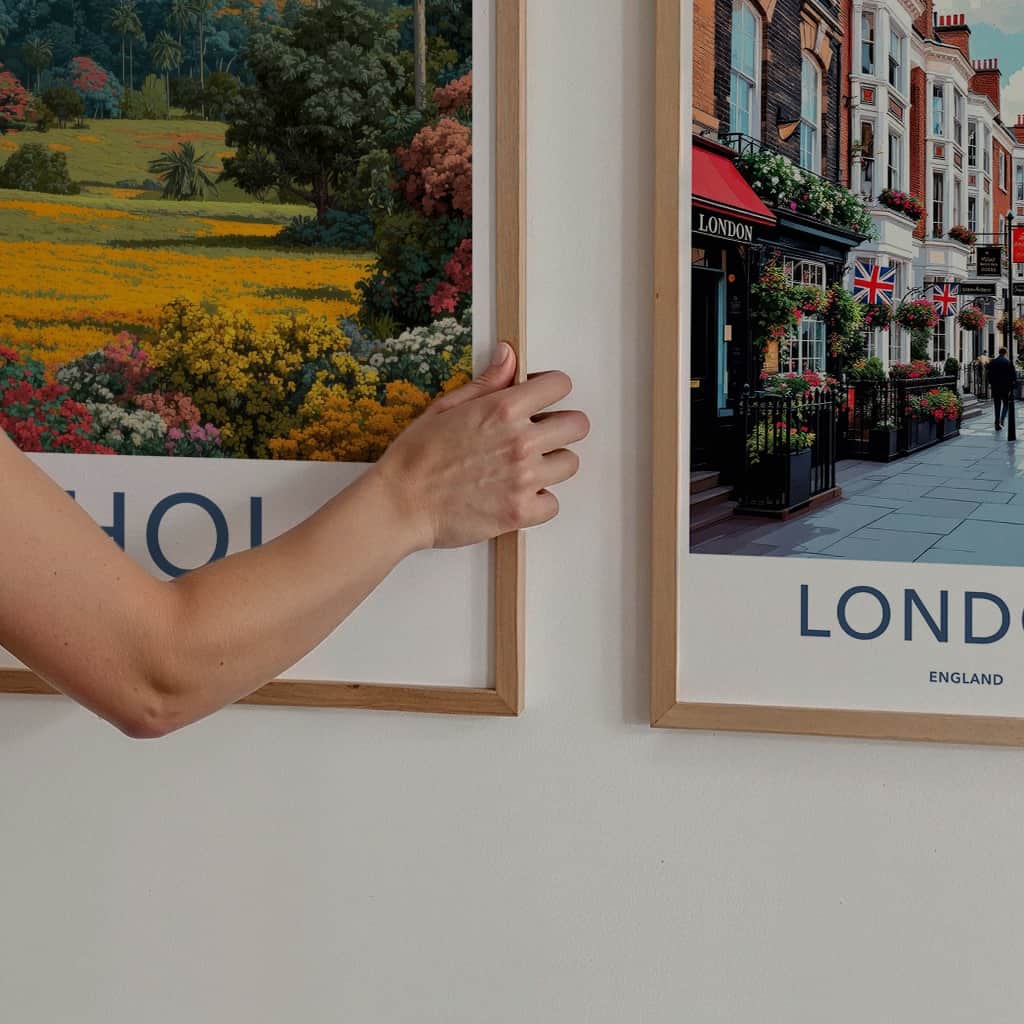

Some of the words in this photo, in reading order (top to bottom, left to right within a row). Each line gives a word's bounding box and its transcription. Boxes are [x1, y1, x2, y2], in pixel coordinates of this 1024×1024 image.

[698, 213, 753, 242] LONDON
[800, 584, 1024, 645] LOND
[929, 671, 1004, 685] ENGLAND
